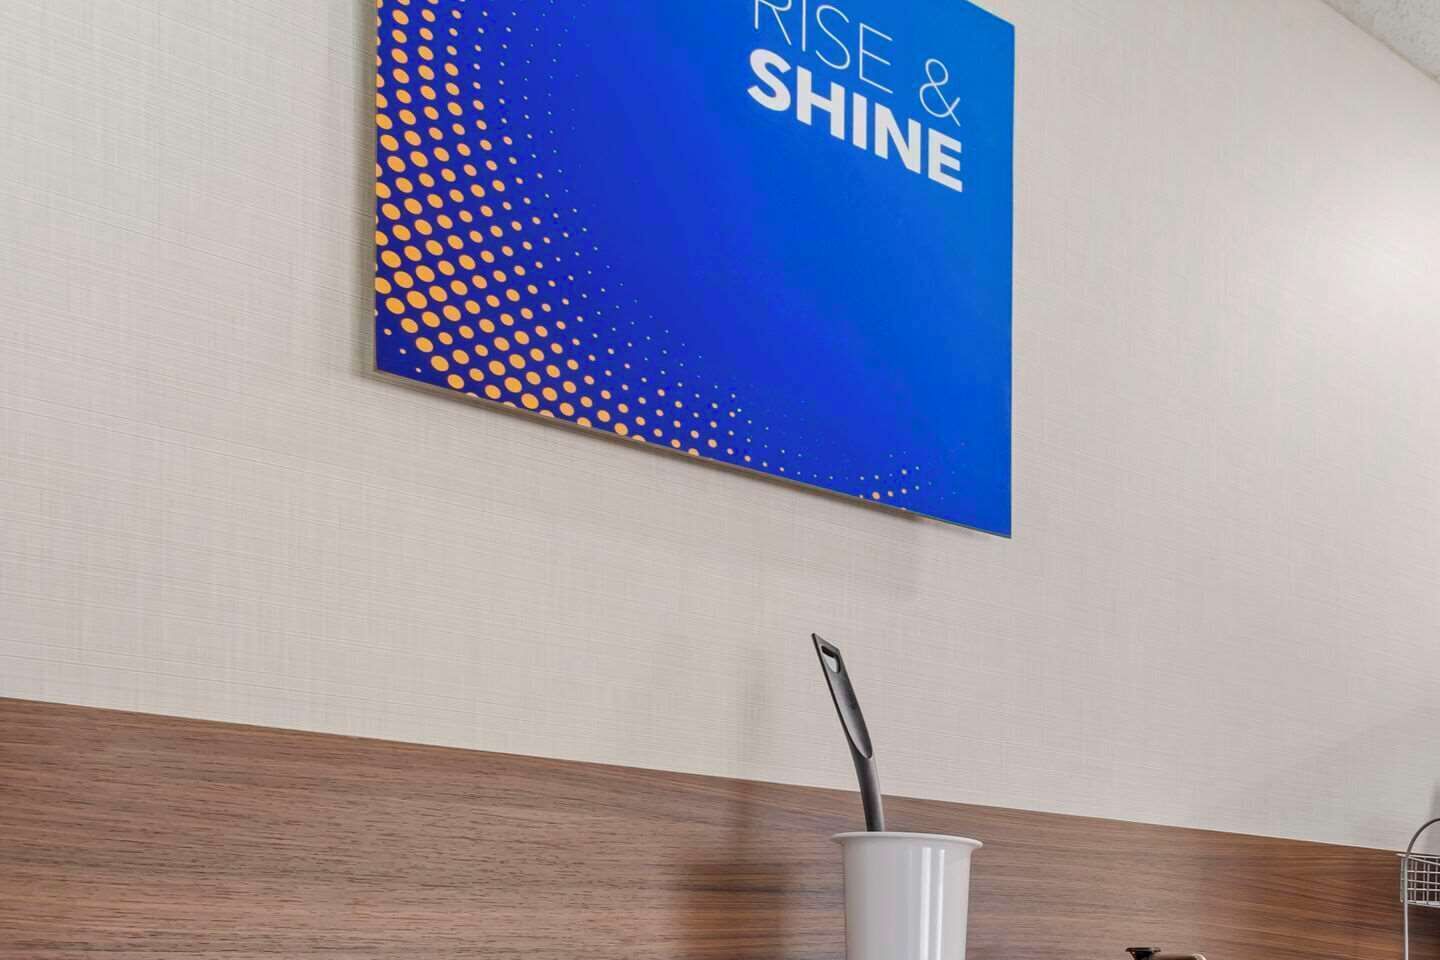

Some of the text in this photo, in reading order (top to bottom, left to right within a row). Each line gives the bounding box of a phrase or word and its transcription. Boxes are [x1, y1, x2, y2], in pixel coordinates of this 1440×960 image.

[747, 48, 963, 193] SHINE
[755, 0, 961, 127] RISE &
